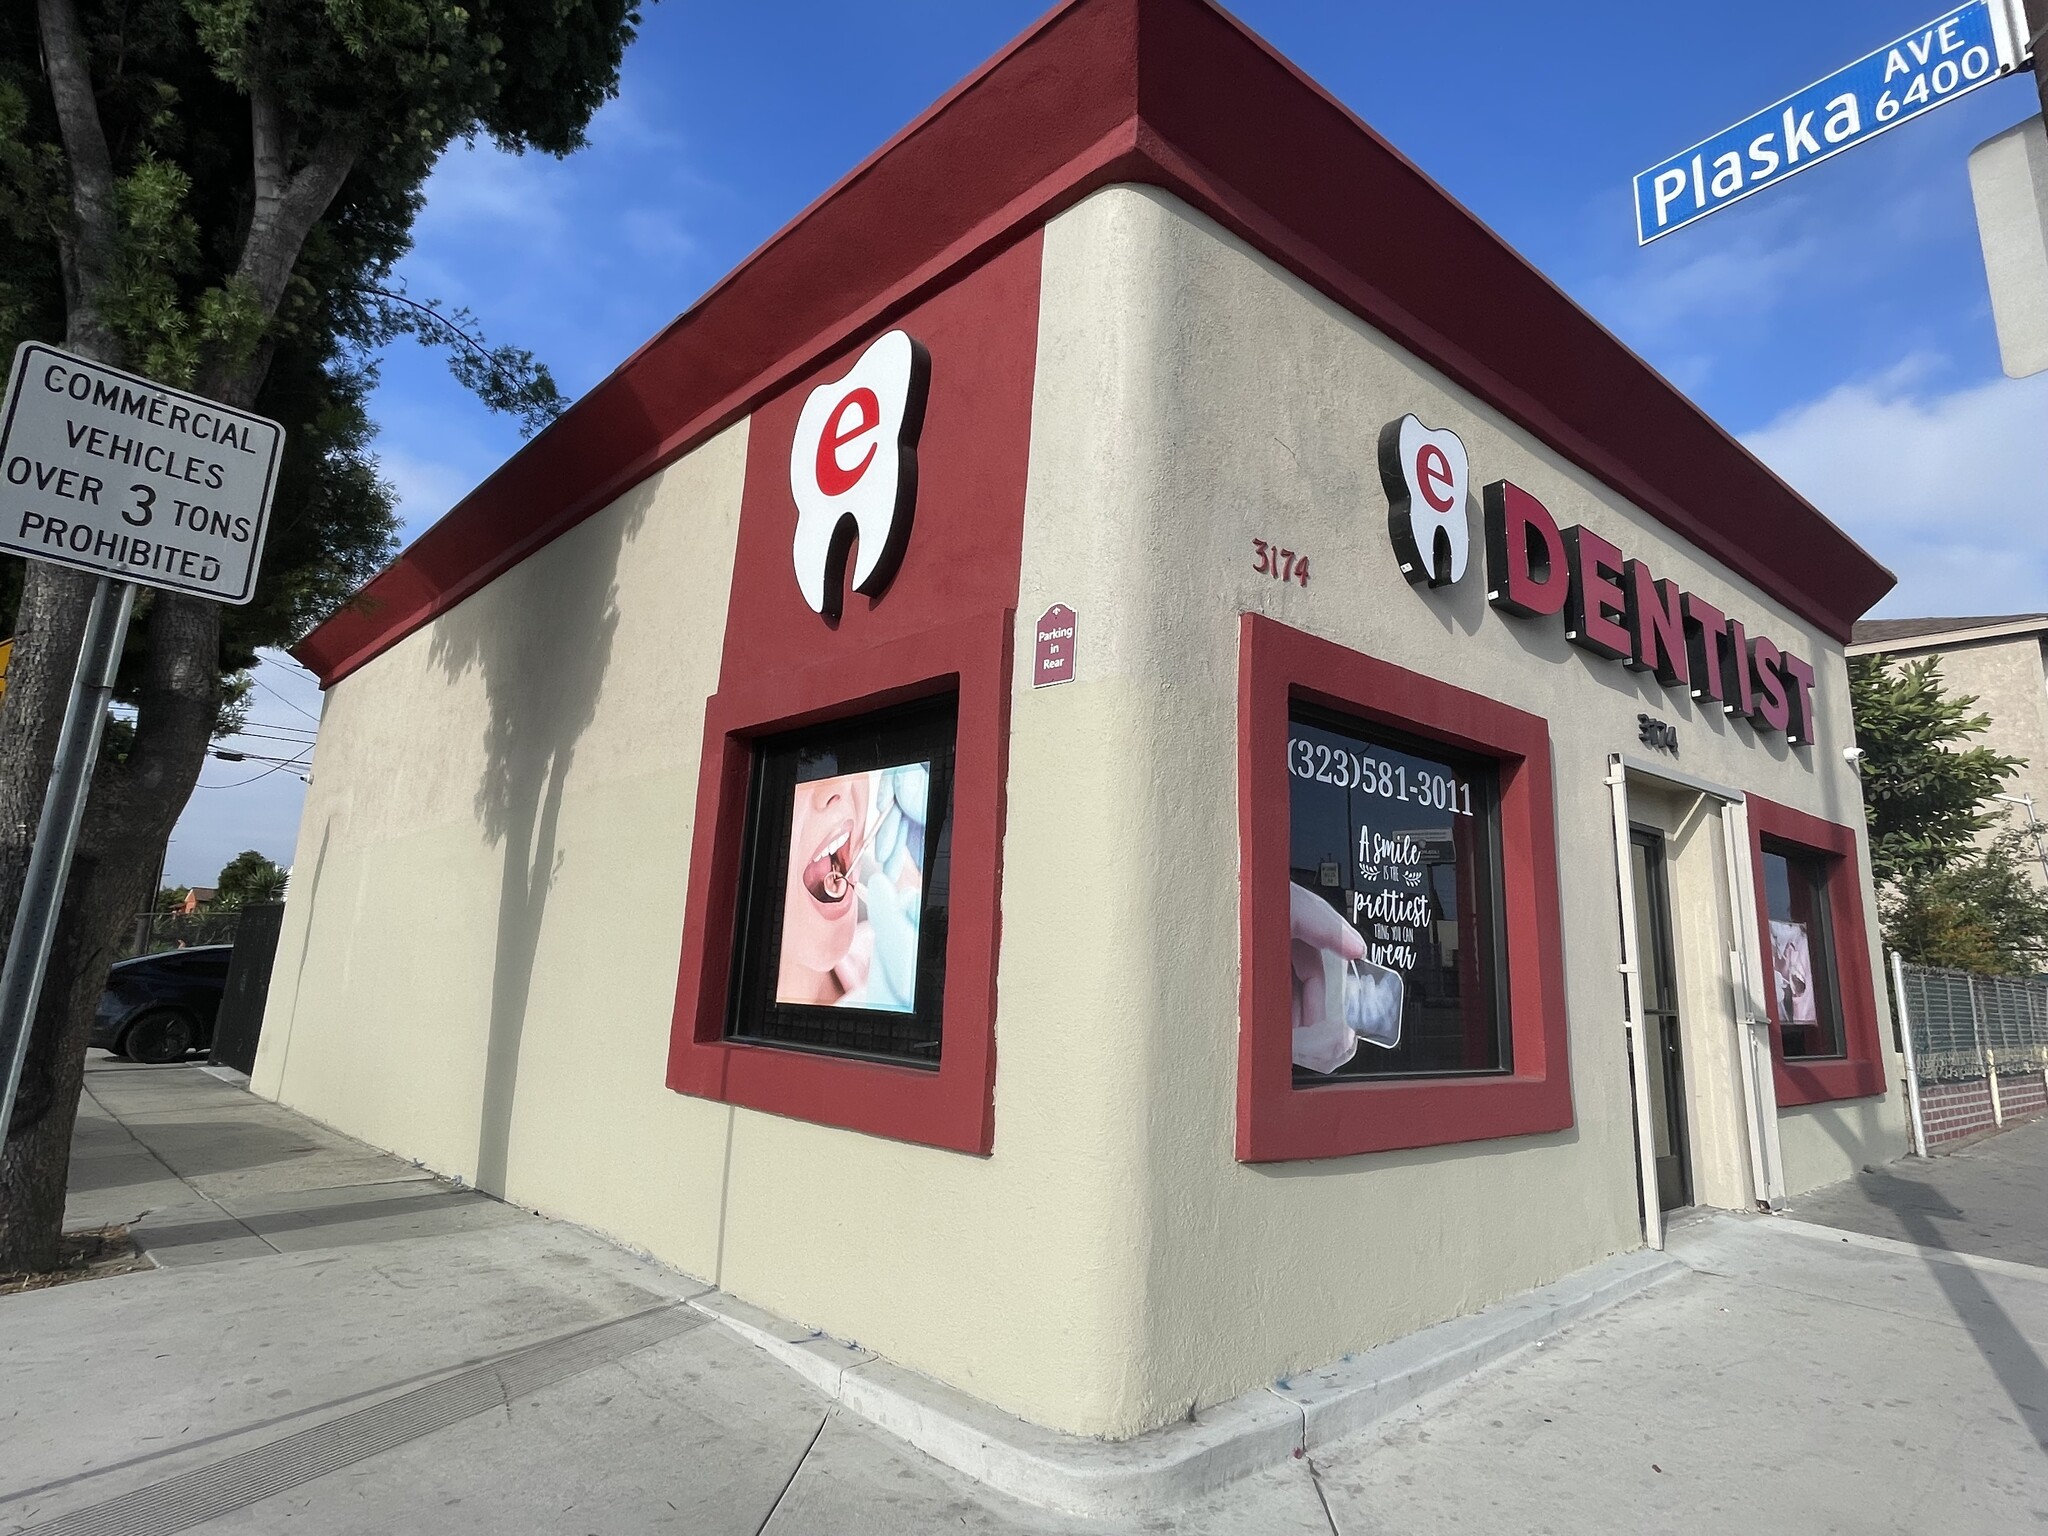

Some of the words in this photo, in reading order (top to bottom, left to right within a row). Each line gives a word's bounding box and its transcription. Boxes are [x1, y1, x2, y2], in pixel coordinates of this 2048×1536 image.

[1875, 45, 1990, 123] 6400
[1653, 92, 1861, 227] Plaska
[1884, 17, 1965, 84] AVE
[44, 364, 257, 455] COMMERCIAL
[815, 387, 880, 497] e
[66, 419, 225, 490] VEHICLES
[1416, 443, 1455, 514] e
[7, 456, 104, 505] OVER
[121, 484, 157, 527] 3
[173, 499, 251, 543] TONS
[18, 511, 221, 582] PROHIBITED
[1252, 537, 1310, 588] 3174
[1038, 627, 1073, 642] Parking
[1498, 478, 1816, 746] DENTIST
[1043, 658, 1065, 670] Rear
[1050, 643, 1060, 654] in
[1287, 738, 1474, 816] (323)581-3011
[1359, 825, 1370, 862] A
[1383, 865, 1389, 880] IS
[1390, 866, 1399, 881] THE
[1353, 888, 1431, 928] prettiest
[1374, 923, 1389, 940] THING
[1402, 926, 1414, 942] CAN
[1371, 943, 1416, 970] wear
